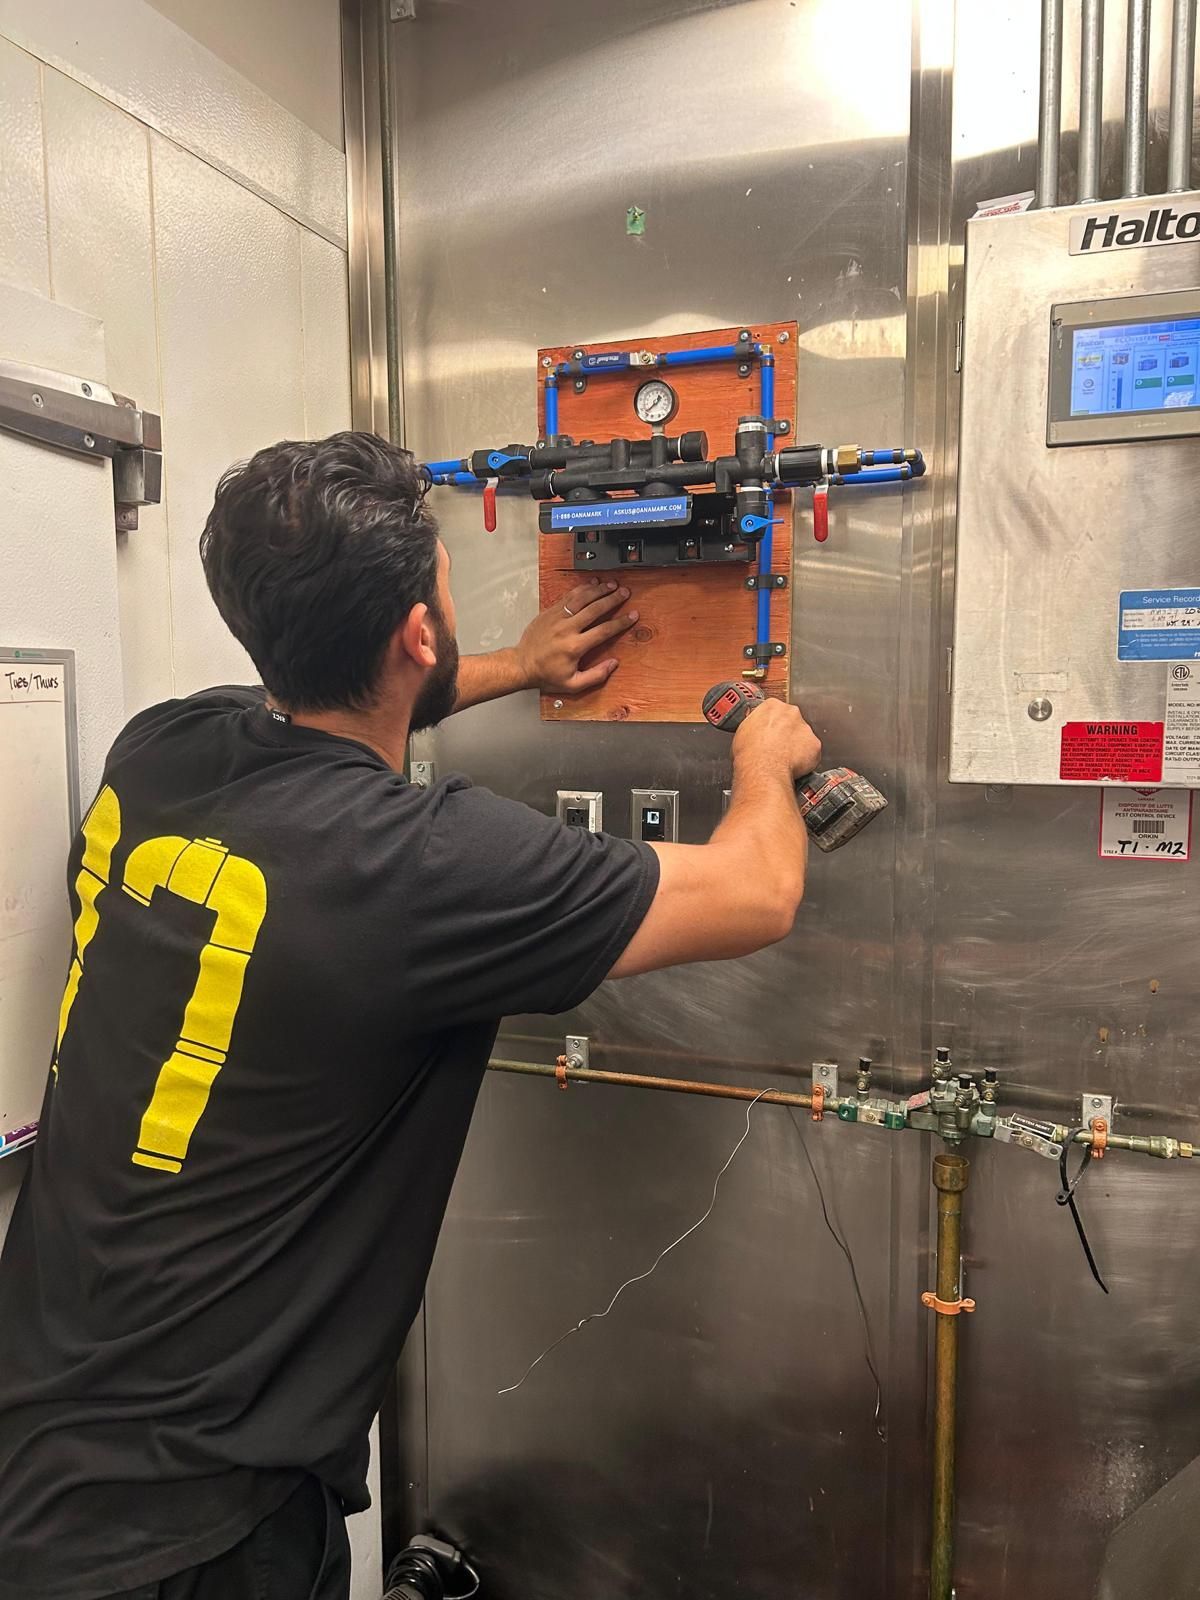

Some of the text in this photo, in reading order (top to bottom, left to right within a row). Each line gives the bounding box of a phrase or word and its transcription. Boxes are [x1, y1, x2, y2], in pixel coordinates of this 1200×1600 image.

[1142, 595, 1200, 604] Service Record
[1087, 725, 1138, 735] WARNING
